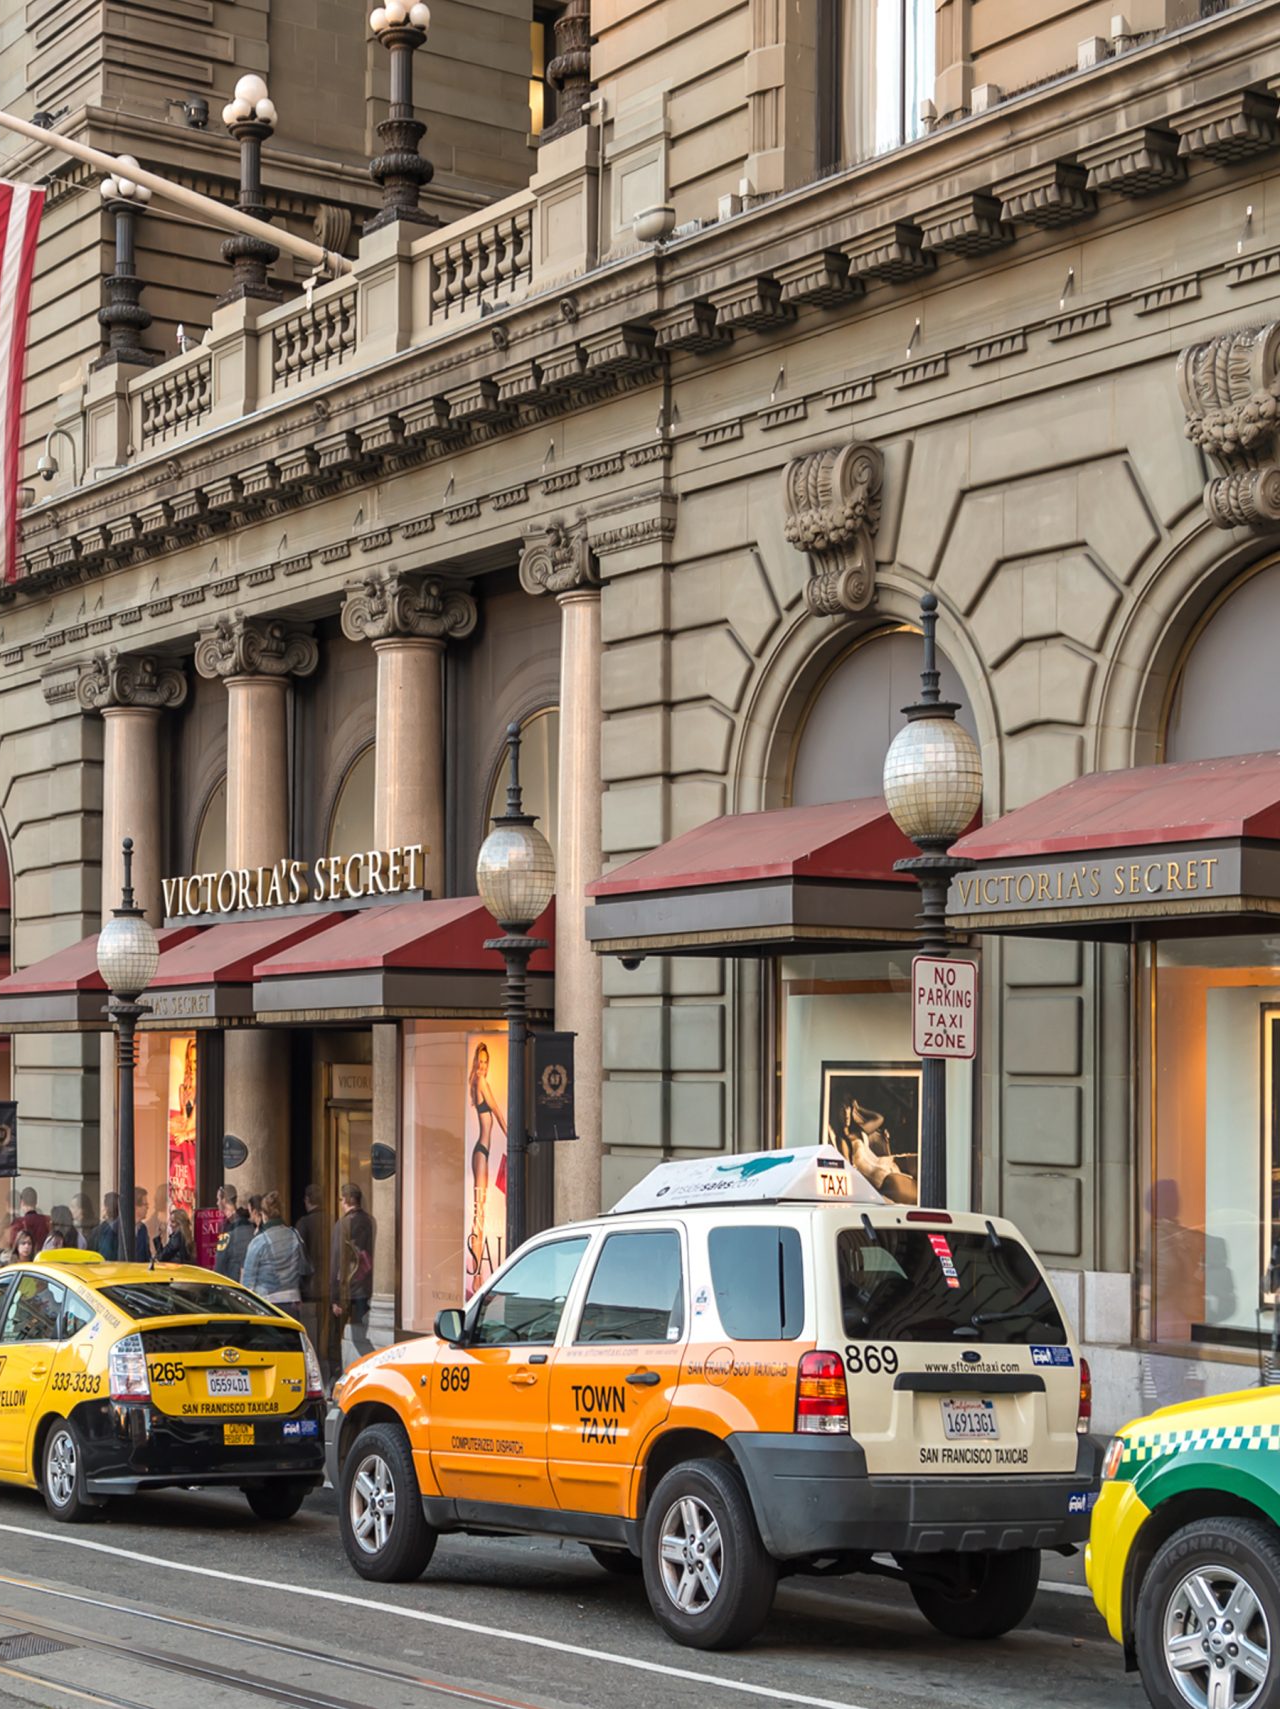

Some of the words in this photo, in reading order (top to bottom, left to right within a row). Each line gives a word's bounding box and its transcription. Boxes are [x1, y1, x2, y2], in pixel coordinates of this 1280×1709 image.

[161, 858, 301, 918] VICTORIA'S
[314, 845, 422, 900] SECRET
[957, 866, 1101, 906] VICTORIA'S
[1114, 858, 1218, 895] SECRET
[934, 967, 956, 986] NO
[171, 993, 211, 1015] SECRET
[918, 987, 972, 1009] PARKING
[928, 1011, 964, 1029] TAXI
[923, 1032, 967, 1050] ZONE
[338, 1075, 371, 1089] VICTOR
[175, 1164, 188, 1178] THE
[820, 1174, 848, 1196] TAXI
[202, 1221, 219, 1235] SAL
[466, 1233, 504, 1276] SAL
[687, 1361, 703, 1376] SAN
[705, 1361, 751, 1377] FRANCISCO
[753, 1362, 788, 1377] TAXICAB
[845, 1344, 899, 1374] 869
[51, 1372, 102, 1394] 333-3333
[148, 1362, 185, 1383] 1265
[440, 1366, 470, 1392] 869
[210, 1378, 250, 1392] 05594D1
[182, 1404, 198, 1414] SAN
[200, 1402, 245, 1414] FRANCISCO
[247, 1402, 279, 1413] TAXICAB
[571, 1385, 626, 1413] TOWN
[580, 1417, 619, 1445] TAXI
[947, 1413, 996, 1433] 16913G1
[451, 1436, 494, 1452] COMPUTERIZED
[496, 1439, 524, 1454] DISPATCH
[919, 1448, 939, 1463] SAN
[941, 1448, 993, 1464] FRANCISCO
[996, 1448, 1029, 1464] TAXICAB
[1165, 1536, 1238, 1568] IRONMAN
